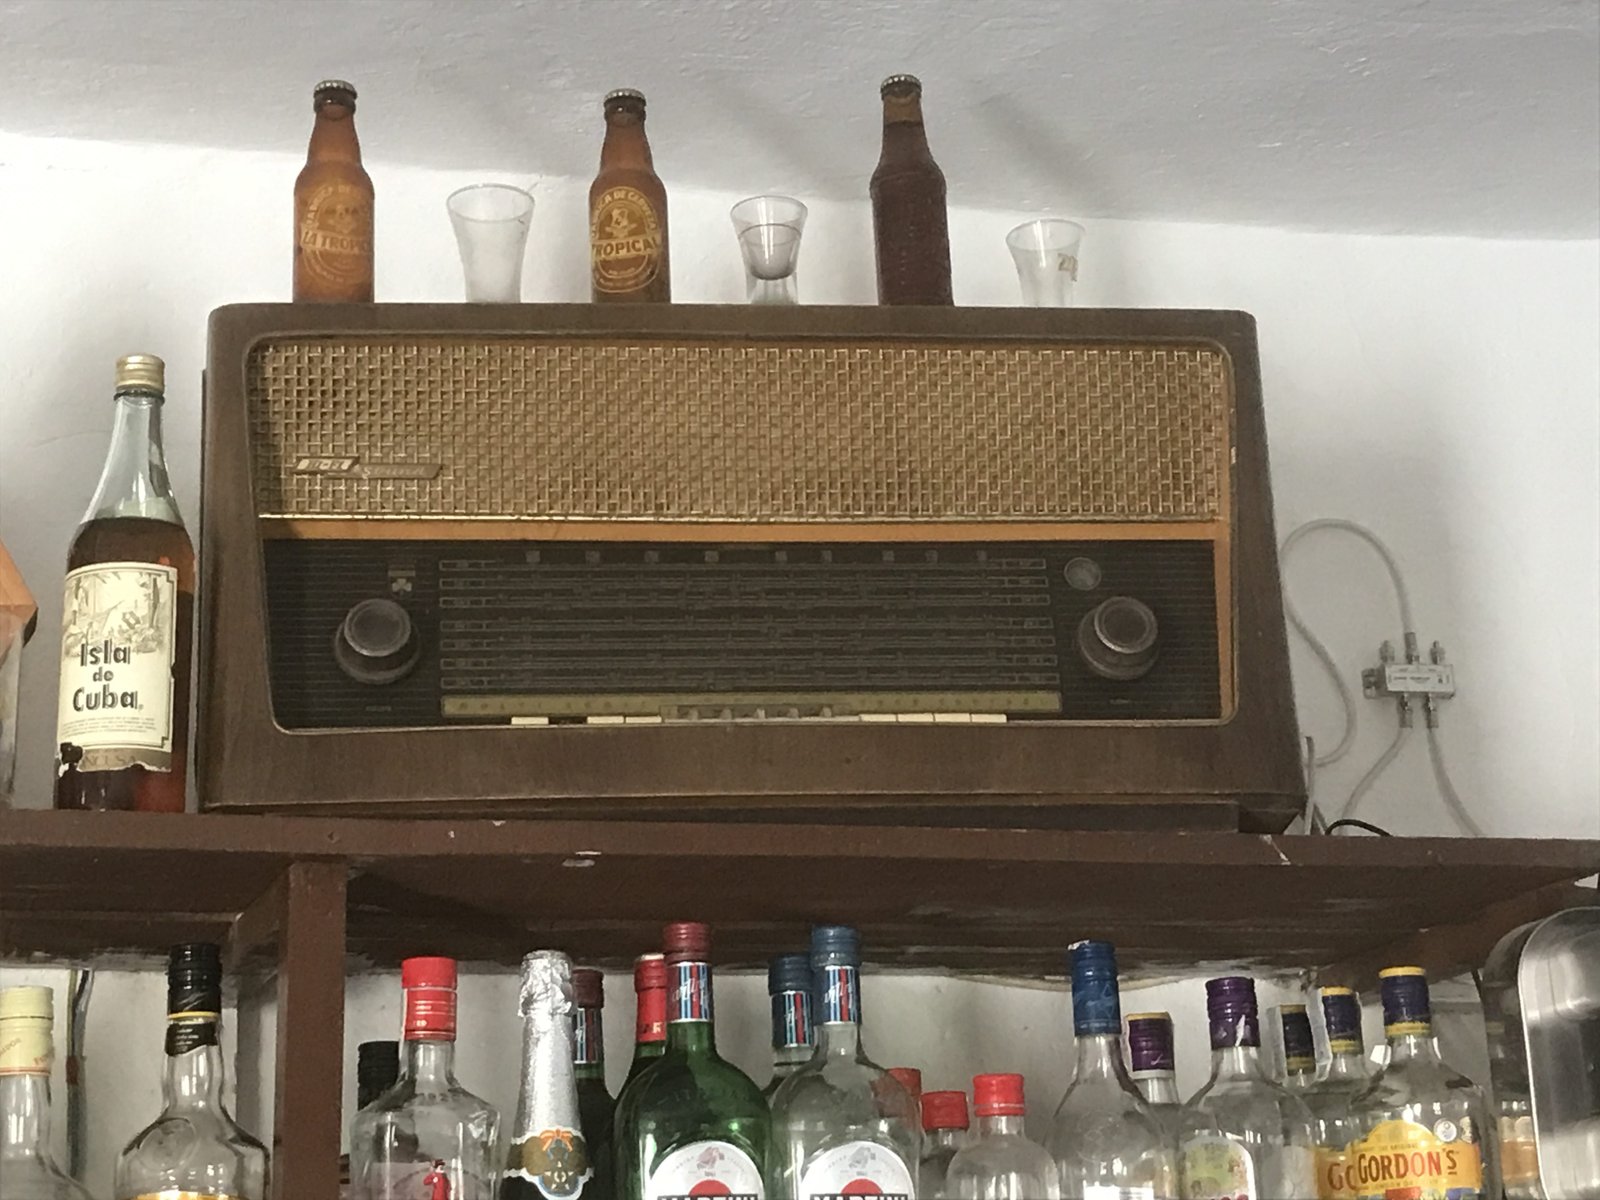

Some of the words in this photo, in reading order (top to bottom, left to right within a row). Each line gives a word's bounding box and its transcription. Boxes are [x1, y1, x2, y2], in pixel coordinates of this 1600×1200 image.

[80, 638, 131, 667] Isla
[93, 667, 114, 682] de
[73, 684, 139, 712] Cuba
[1358, 1148, 1458, 1184] GORDON'S
